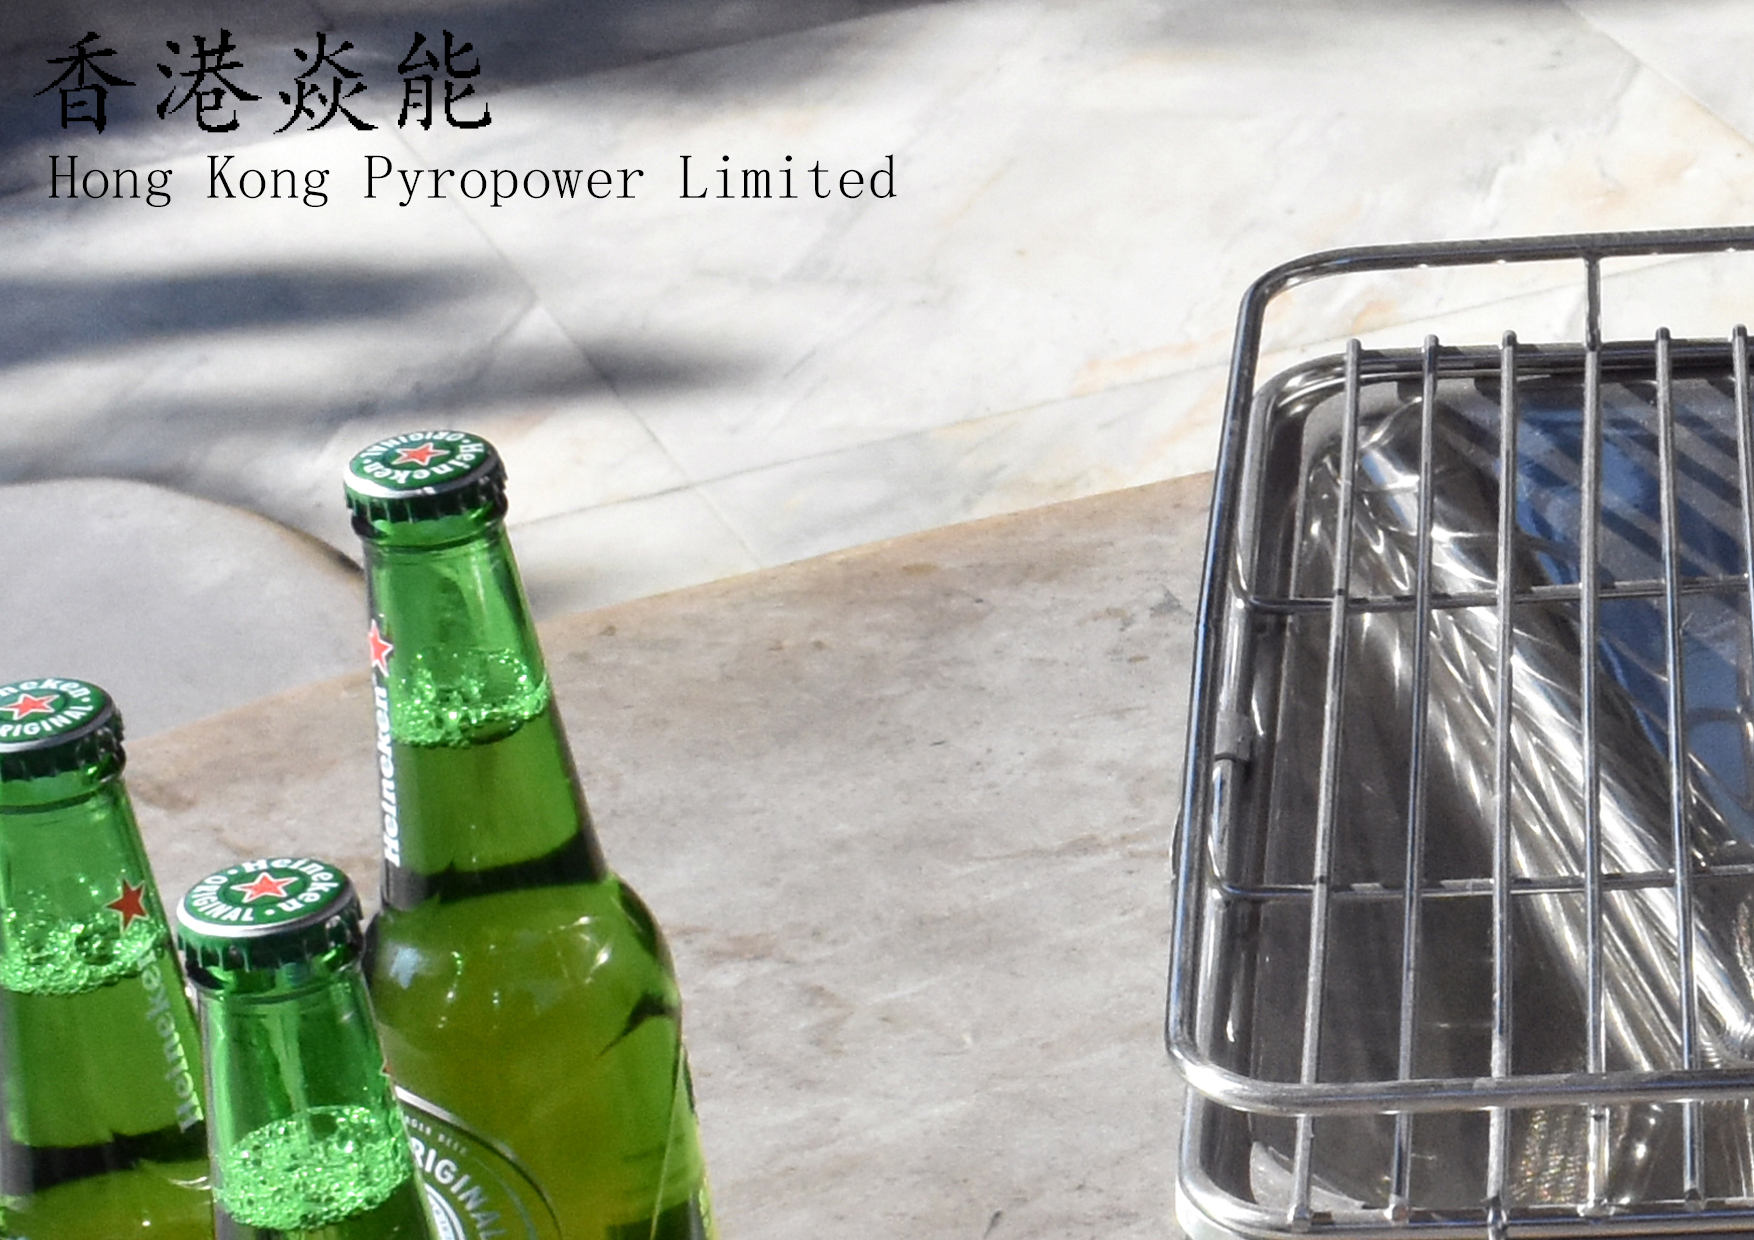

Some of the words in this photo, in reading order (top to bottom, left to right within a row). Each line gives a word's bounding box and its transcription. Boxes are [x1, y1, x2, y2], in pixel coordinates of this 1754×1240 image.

[359, 431, 465, 459] ORIGINAL
[363, 442, 485, 484] Heineken
[0, 678, 91, 699] neken
[0, 704, 94, 738] RIGINAL
[373, 685, 401, 868] Heineken
[191, 874, 255, 922] ORIGINAL
[241, 858, 339, 912] Heineken
